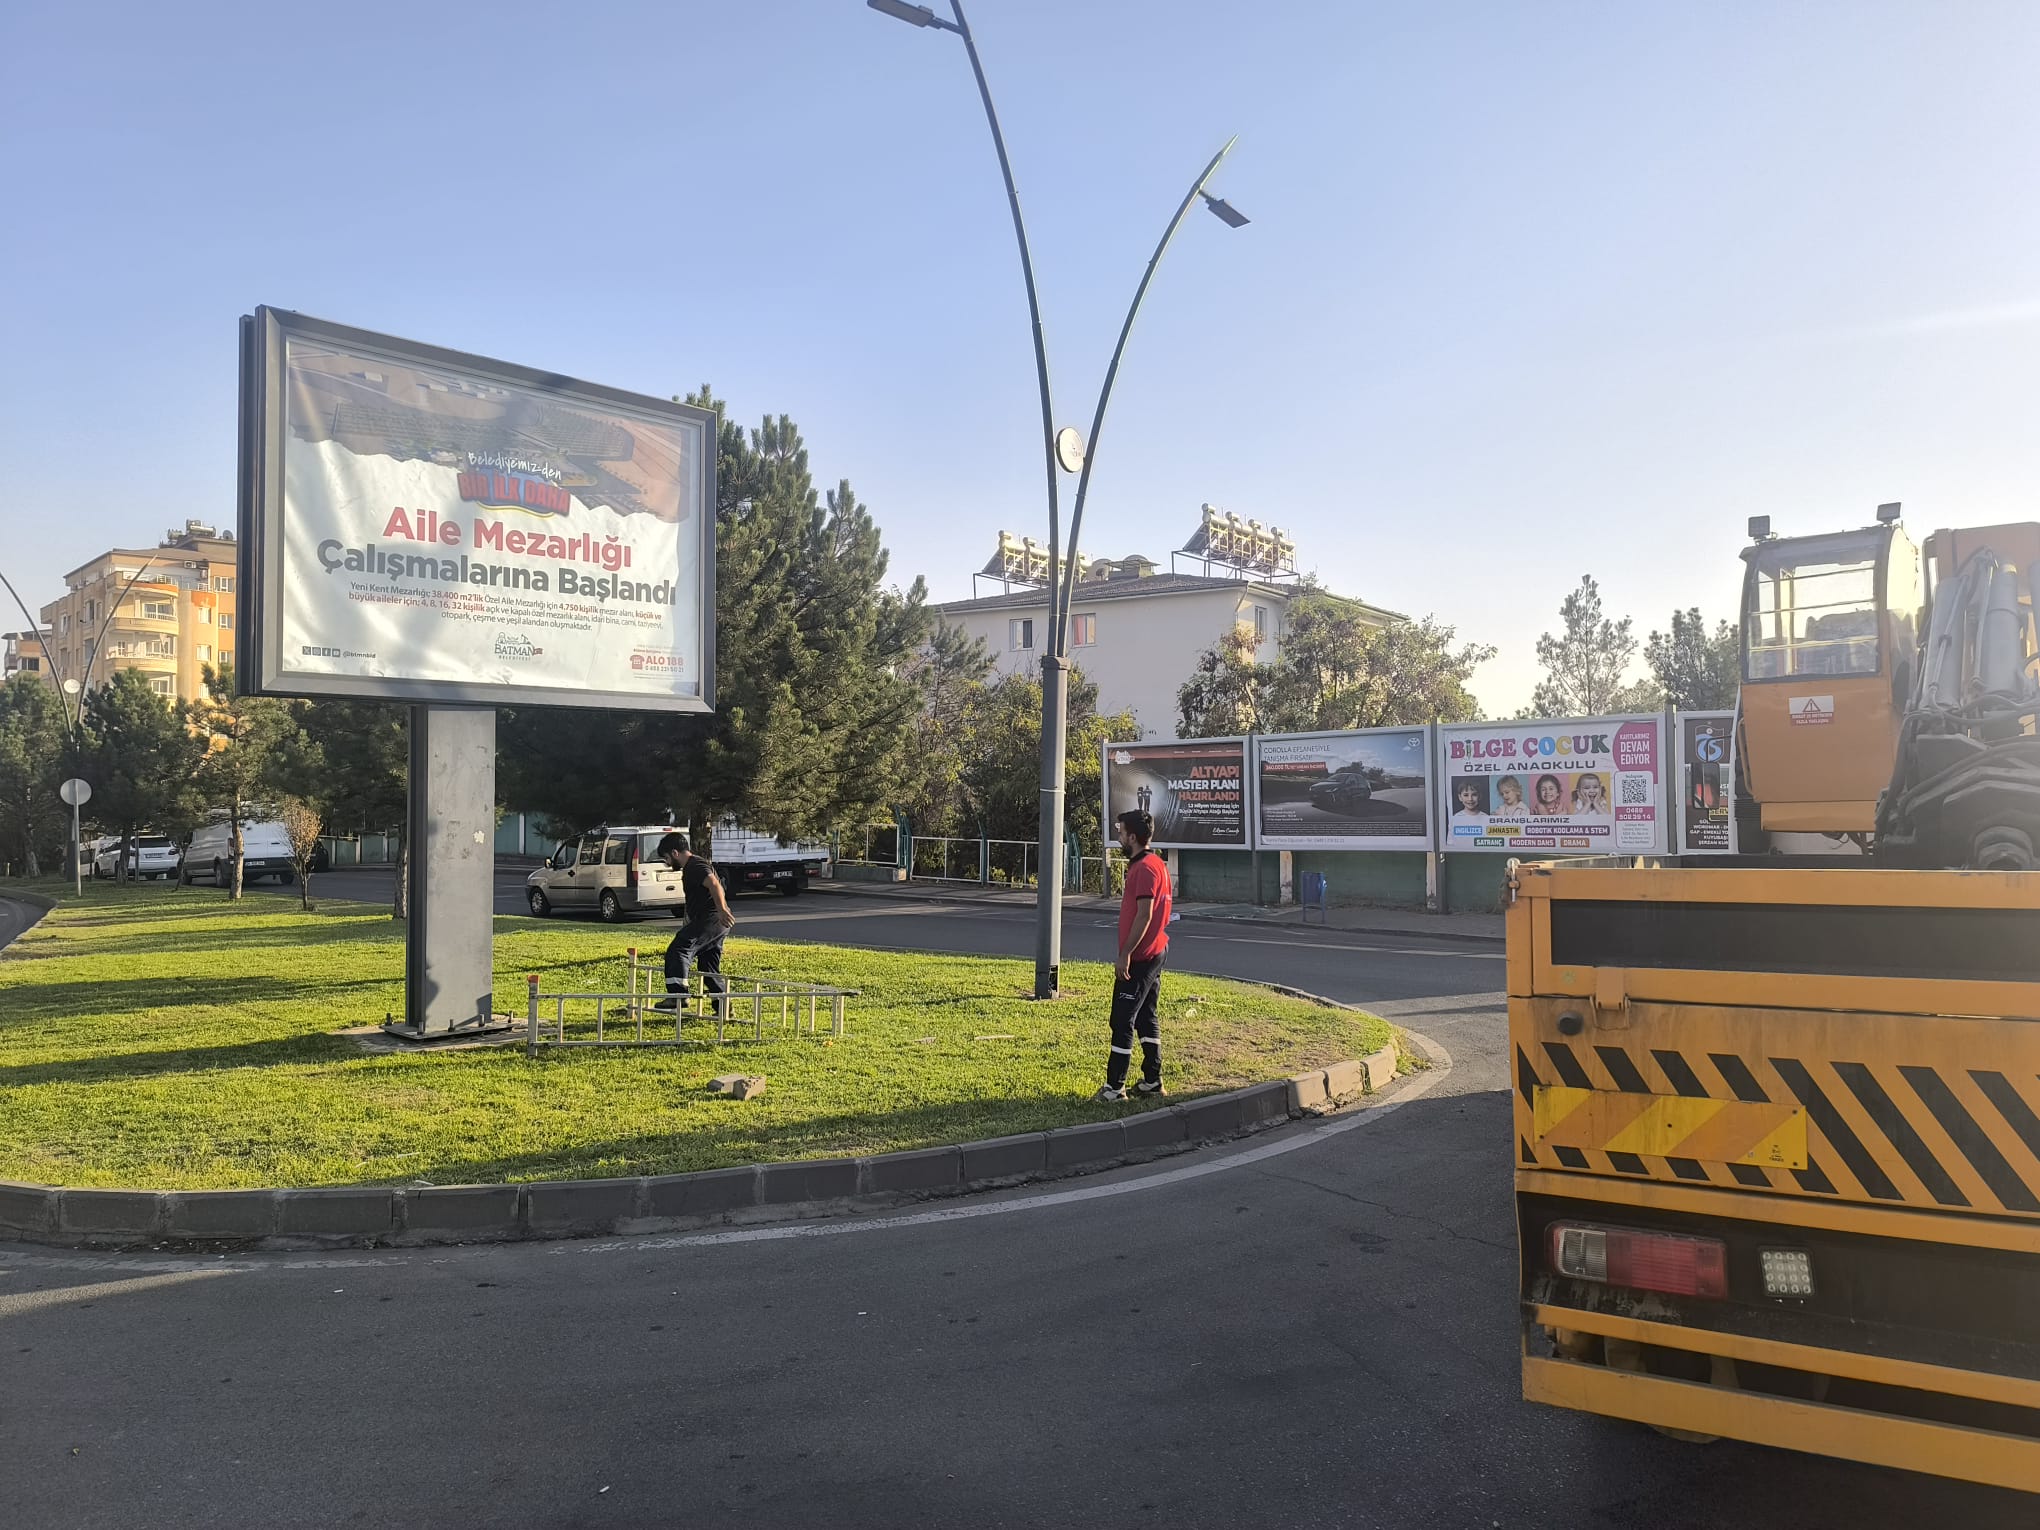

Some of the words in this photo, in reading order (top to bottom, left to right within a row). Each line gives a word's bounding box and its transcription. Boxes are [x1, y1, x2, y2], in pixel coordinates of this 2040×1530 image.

[383, 506, 461, 545] Aile
[474, 518, 631, 571] Mezarlığı
[317, 539, 549, 592] Çalışmalarına
[559, 567, 675, 606] Başlandı
[351, 582, 368, 592] Yeni
[370, 584, 389, 593] Kent
[432, 590, 458, 600] 38.400
[485, 594, 500, 604] Özel
[502, 597, 514, 605] Aile
[516, 598, 545, 610] Mezarlığı
[547, 601, 558, 610] için
[580, 605, 598, 614] kişilik
[600, 608, 618, 616] mezar
[349, 592, 375, 603] büyük
[377, 594, 402, 604] aileler
[452, 601, 461, 609] 32
[463, 603, 485, 612] kişilik
[511, 608, 531, 617] kapalı
[546, 611, 573, 620] mezarlık
[441, 611, 471, 621] otopark,
[473, 614, 496, 624] çeşme
[507, 617, 522, 625] yeşil
[523, 618, 548, 627] alandan
[495, 643, 534, 656] BATMAN
[645, 655, 665, 665] ALO
[667, 656, 684, 666] 188
[1450, 738, 1517, 759] BİLGE
[1523, 735, 1610, 758] ÇOCUK
[1620, 741, 1650, 753] DEVAM
[1621, 753, 1650, 764] EDİYOR
[1190, 766, 1239, 779] ALTYAPI
[1464, 762, 1501, 772] ÖZEL
[1507, 760, 1596, 771] ANAOKULU
[1168, 780, 1209, 790] MASTER
[1211, 780, 1239, 790] PLANI
[1179, 791, 1239, 801] HAZIRLANDI
[1476, 839, 1502, 847] SATRANÇ
